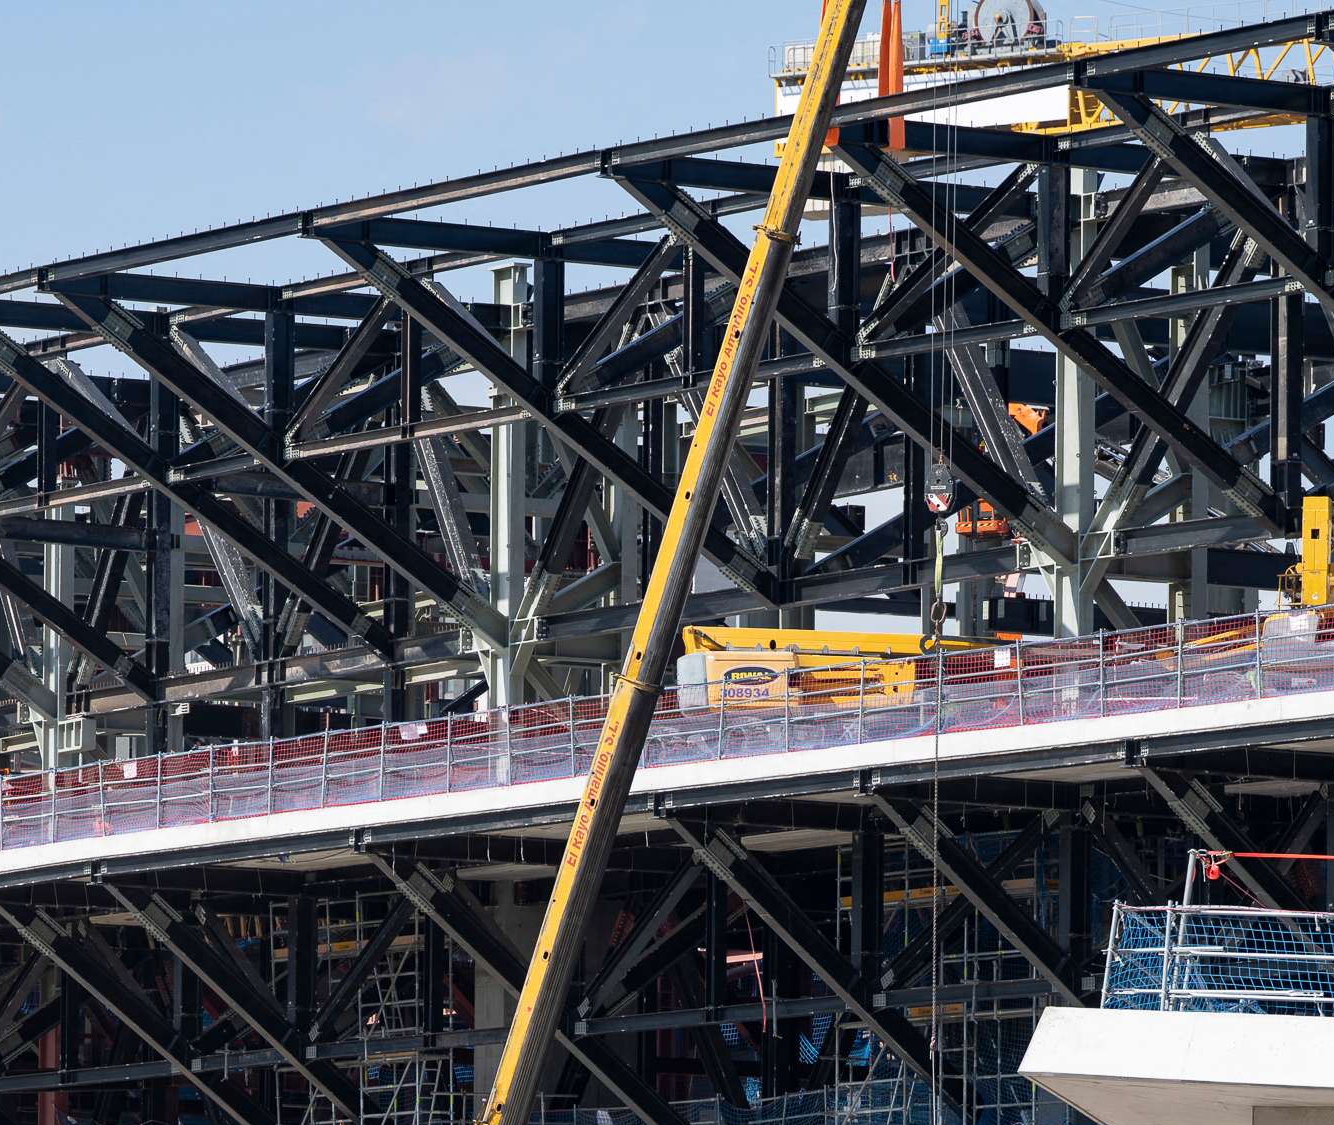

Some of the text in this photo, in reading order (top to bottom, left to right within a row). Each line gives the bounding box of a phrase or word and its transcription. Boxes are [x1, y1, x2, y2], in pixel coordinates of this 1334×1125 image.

[705, 402, 716, 417] El
[711, 361, 728, 401] Rayo
[745, 260, 760, 288] S.L.
[566, 850, 578, 868] El
[573, 813, 591, 853] Rayo
[604, 720, 620, 746] S.L.
